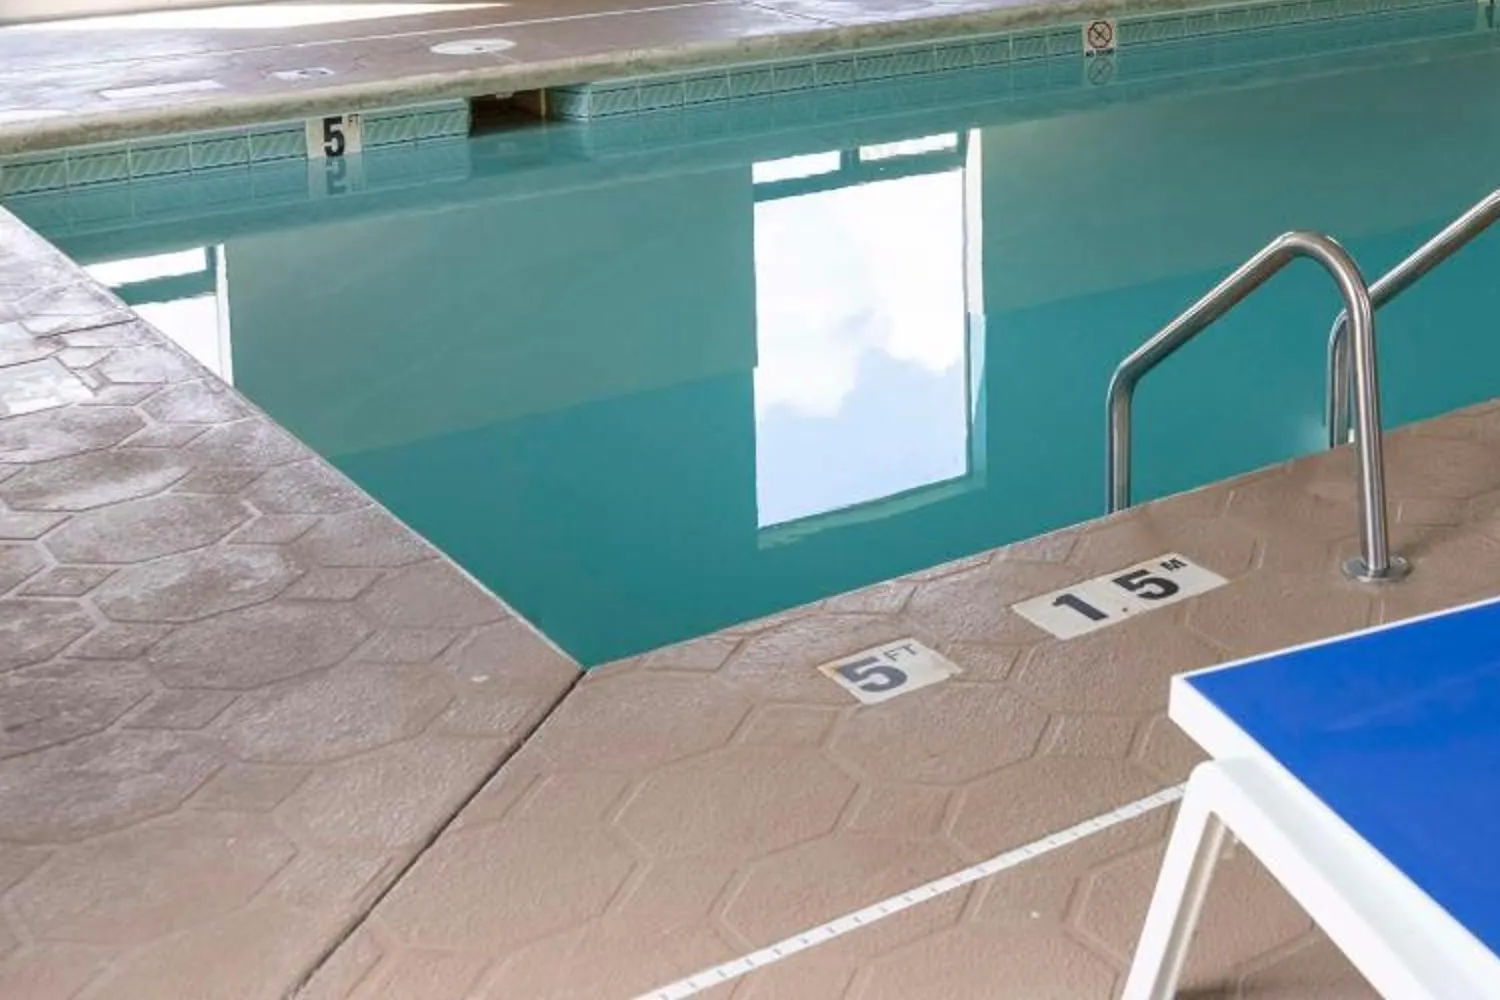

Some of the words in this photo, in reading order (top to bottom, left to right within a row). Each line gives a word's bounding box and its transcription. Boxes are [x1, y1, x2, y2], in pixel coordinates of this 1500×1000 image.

[323, 116, 345, 156] 5
[836, 656, 908, 693] 5
[883, 643, 917, 662] FT
